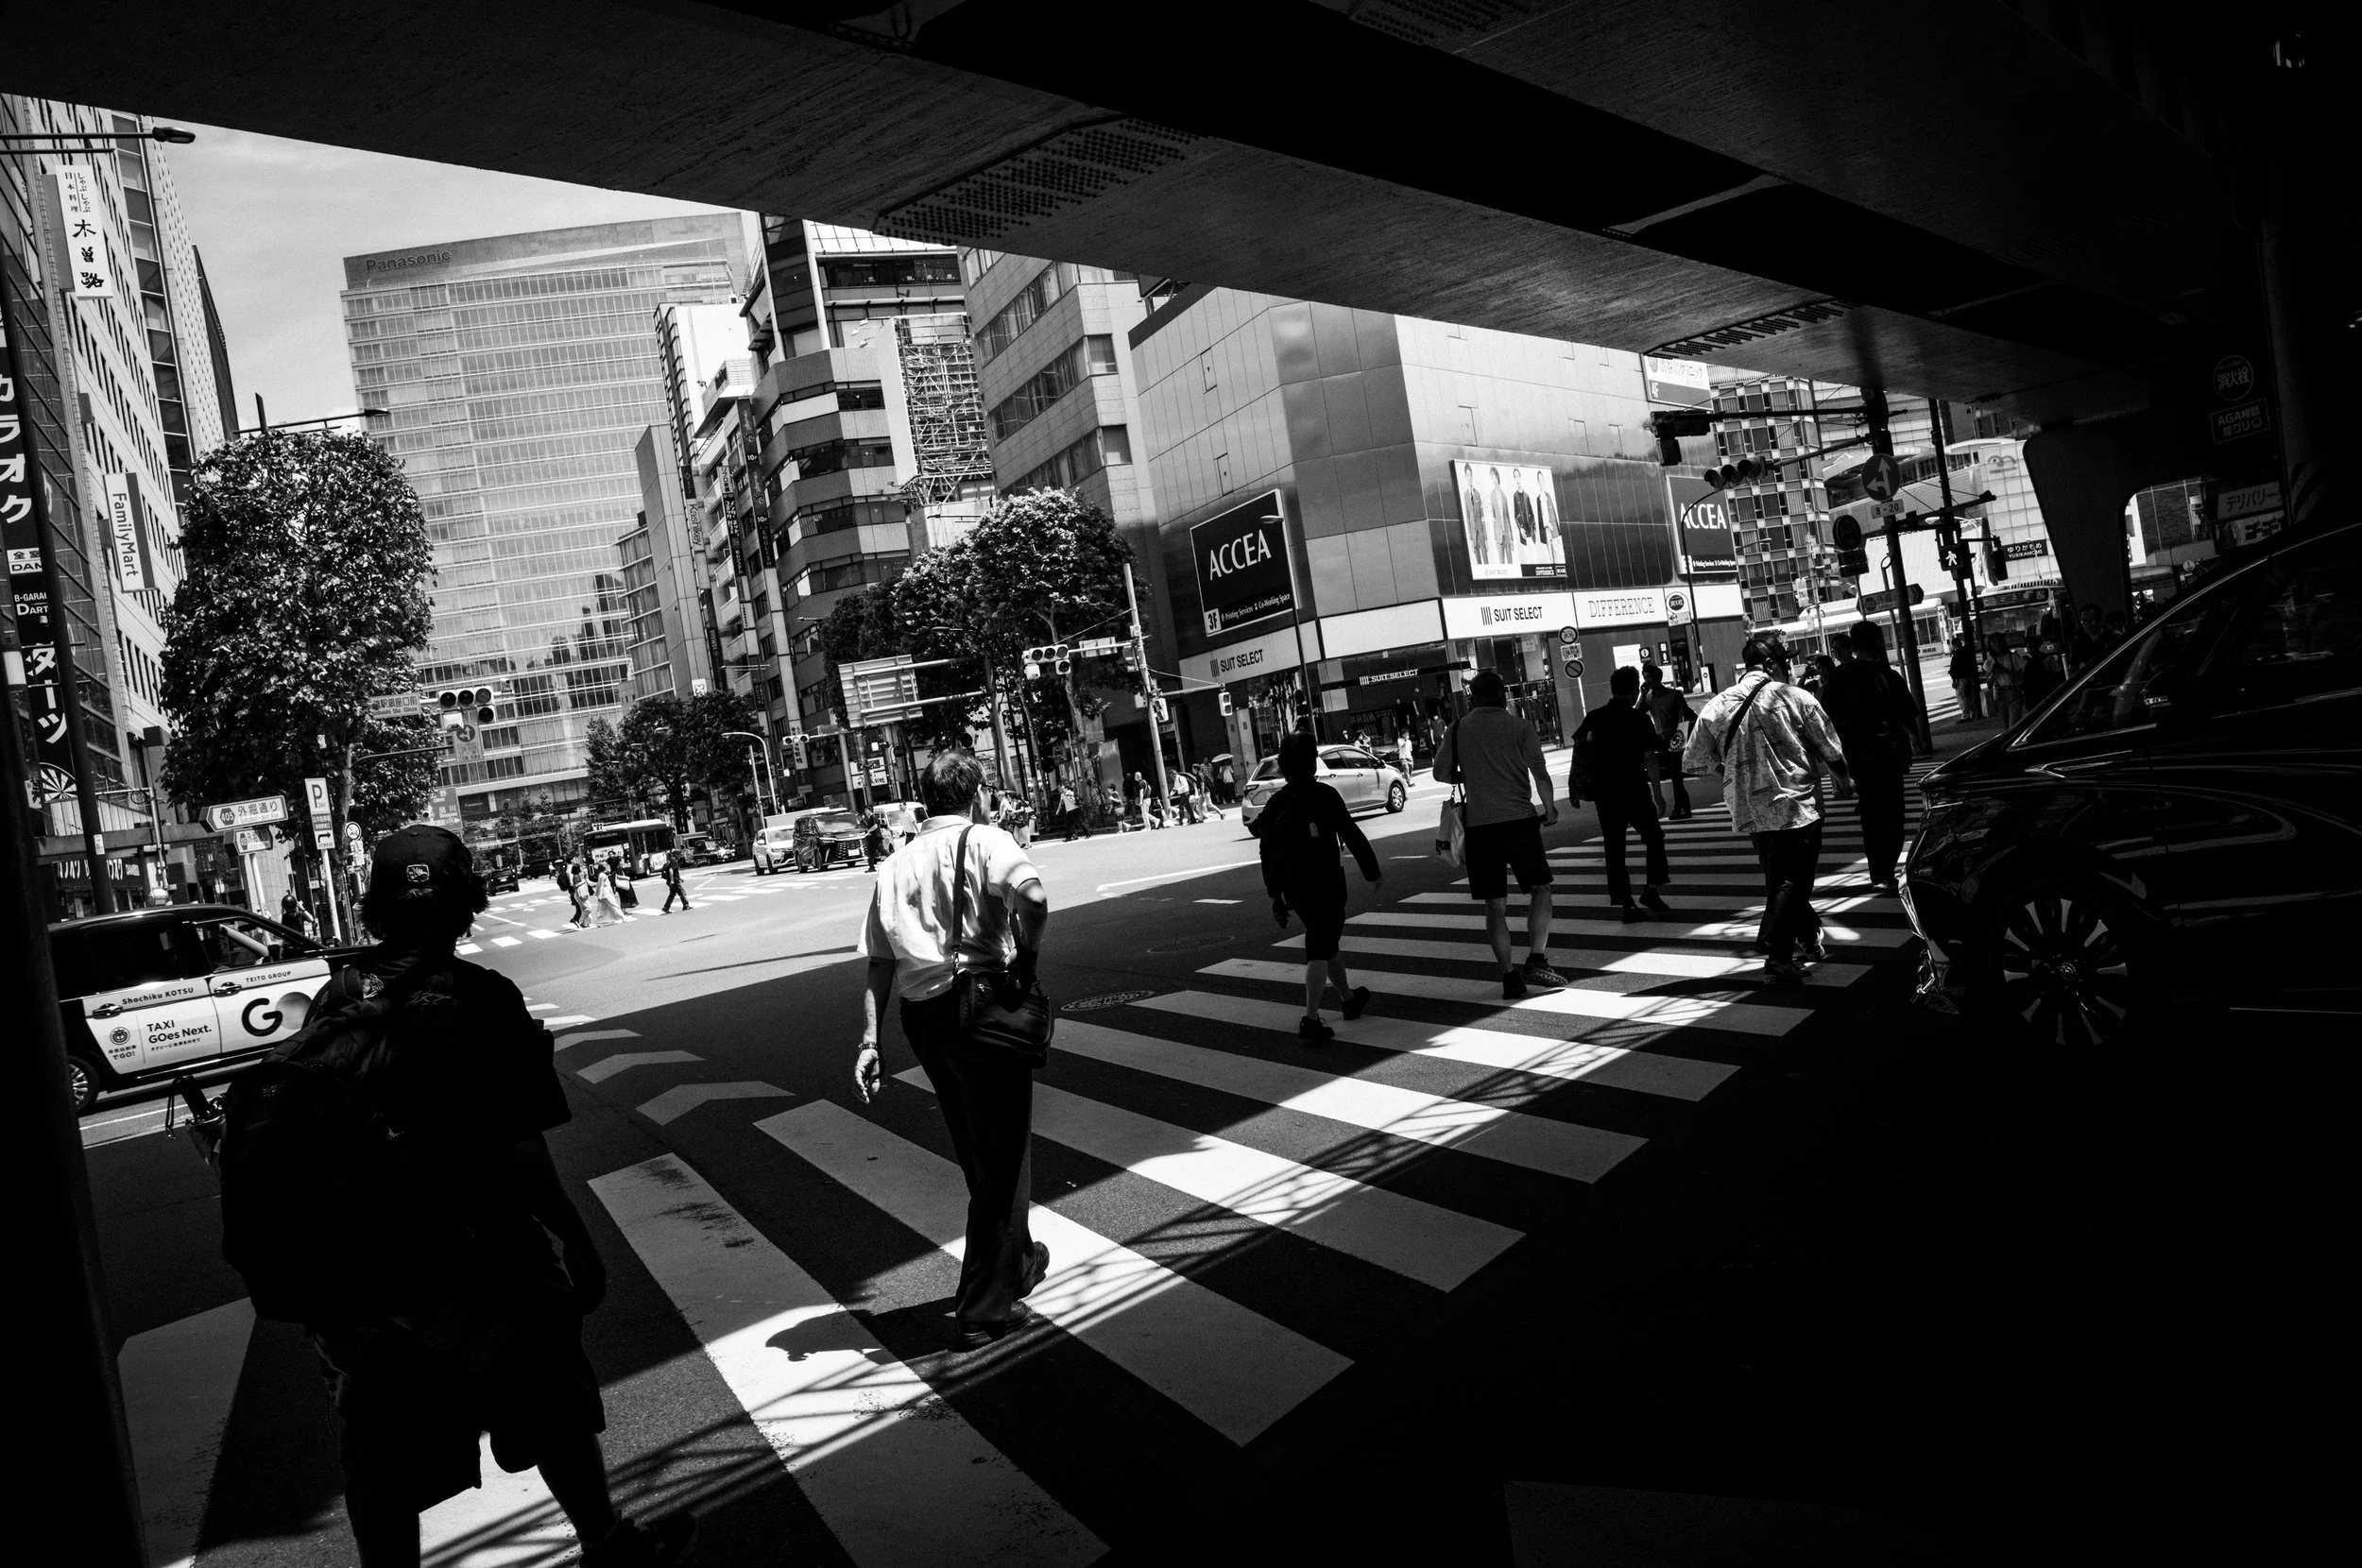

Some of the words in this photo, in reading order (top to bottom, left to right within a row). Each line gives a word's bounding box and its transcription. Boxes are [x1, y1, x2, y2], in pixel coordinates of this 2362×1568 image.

[64, 172, 78, 213] 日本料理
[72, 218, 105, 289] 木曽路
[365, 248, 452, 273] Panasonic
[2217, 366, 2251, 390] 消火栓
[1681, 503, 1727, 529] ACCEA
[111, 492, 139, 578] FamilyMart
[1209, 529, 1272, 581] ACCEA
[2007, 542, 2042, 553] ゆりかもめ
[1239, 605, 1254, 616] Services
[1494, 607, 1512, 622] SUIT
[1514, 606, 1543, 621] SELECT
[1588, 597, 1654, 618] DIFFERENCE
[1207, 611, 1218, 630] 3F
[1220, 656, 1236, 673] SUIT
[1237, 649, 1263, 668] SELECT
[1371, 673, 1388, 683] SUIT
[1390, 669, 1418, 679] SELECT
[25, 641, 68, 744] ダーツ
[311, 784, 323, 809] P
[220, 811, 234, 822] 405
[267, 971, 292, 980] GROUP
[122, 993, 163, 1005] Shochiku
[164, 987, 195, 997] KOTSU
[146, 1019, 176, 1032] TAXI
[148, 1031, 180, 1044] GOes
[181, 1025, 213, 1038] Next.
